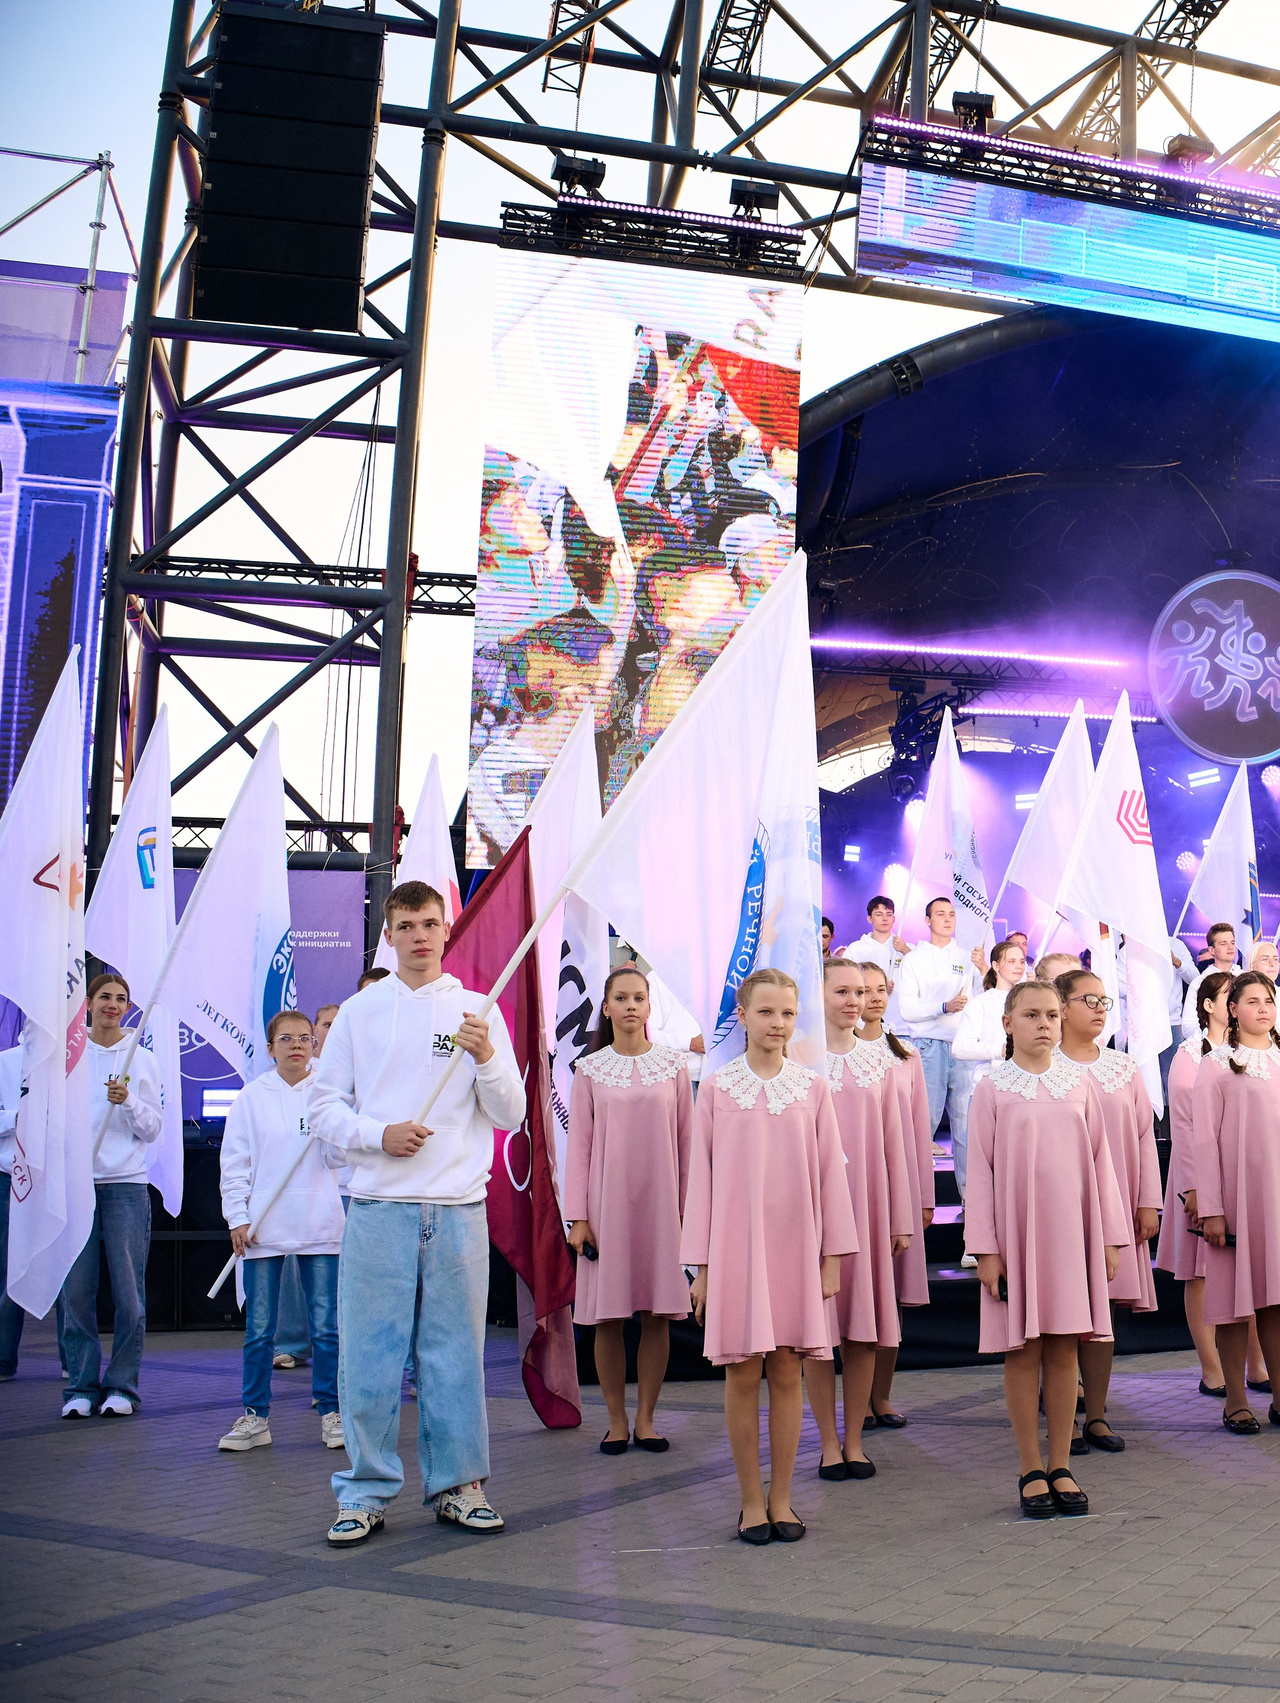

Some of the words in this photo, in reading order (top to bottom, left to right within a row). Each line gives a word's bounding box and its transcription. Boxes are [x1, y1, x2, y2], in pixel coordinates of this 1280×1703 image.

[290, 930, 339, 939] оддержки
[299, 940, 352, 948] инициатив
[196, 999, 245, 1046] ЛЕГКОЙ
[13, 1154, 28, 1186] СК
